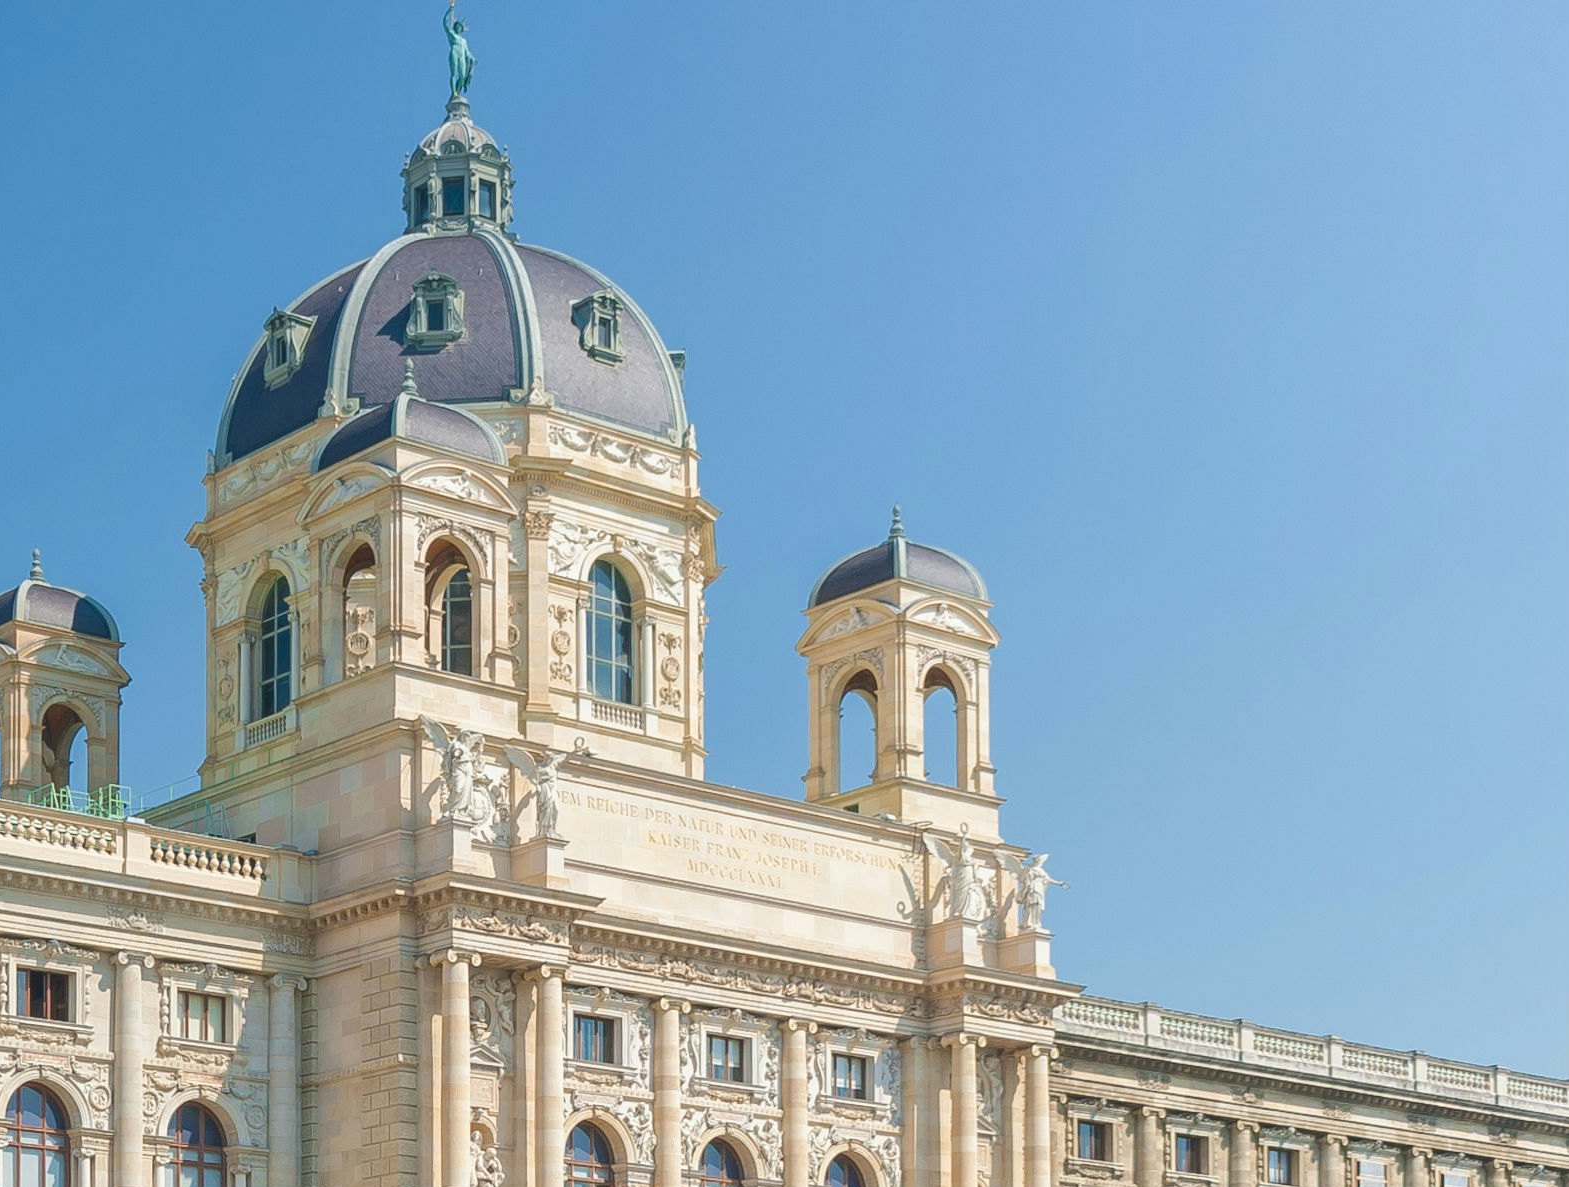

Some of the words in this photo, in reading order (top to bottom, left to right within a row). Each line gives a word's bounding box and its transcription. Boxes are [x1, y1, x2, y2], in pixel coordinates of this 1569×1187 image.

[587, 796, 638, 818] REICHE
[645, 807, 672, 825] DER
[677, 815, 724, 836] NATUR
[730, 823, 758, 842] UND
[763, 832, 808, 853] SEINER
[647, 830, 700, 853] KAISER
[706, 842, 749, 862] FRANZ
[755, 852, 808, 874] JOSEPH
